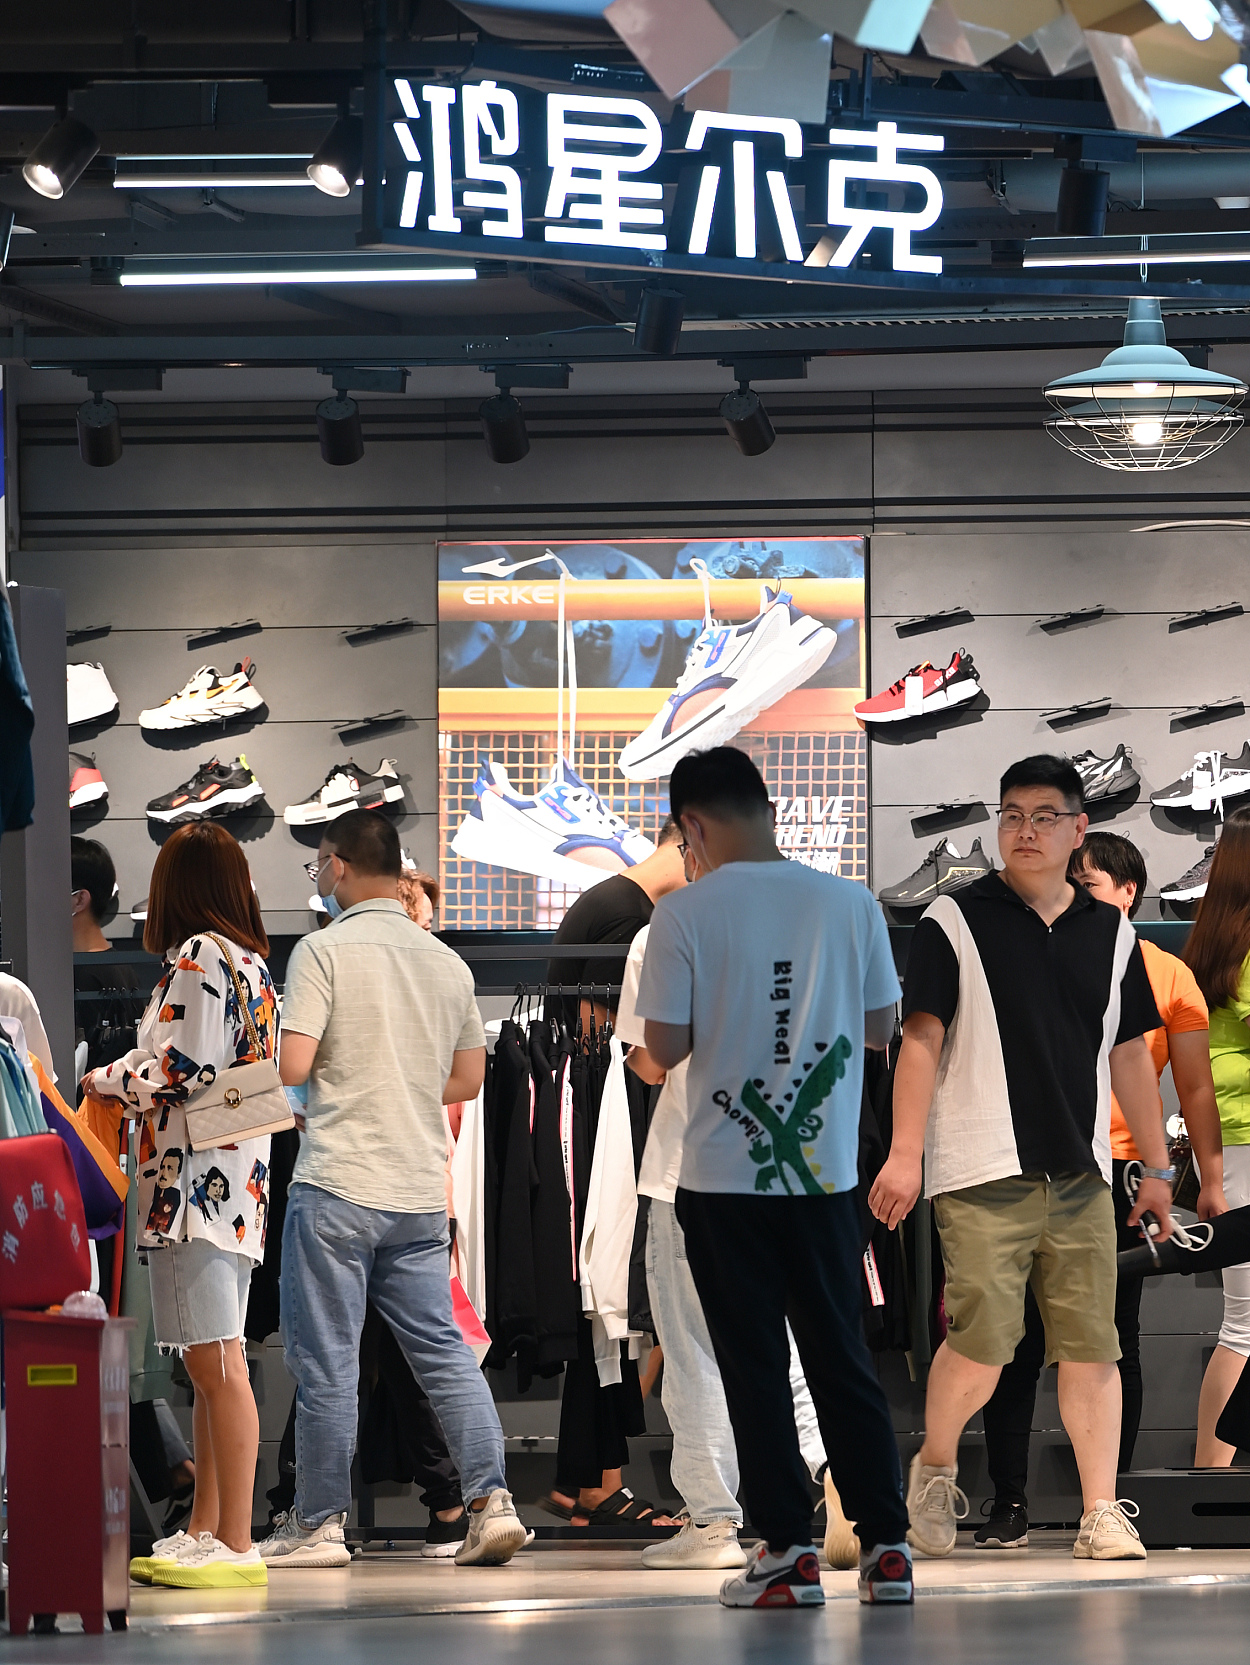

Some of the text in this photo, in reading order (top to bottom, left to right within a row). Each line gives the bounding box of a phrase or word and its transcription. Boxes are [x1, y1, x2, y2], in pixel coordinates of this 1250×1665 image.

[393, 78, 945, 275] 鸿星尔克
[463, 585, 555, 605] ERKE
[775, 824, 848, 846] REND
[770, 961, 793, 1001] Big
